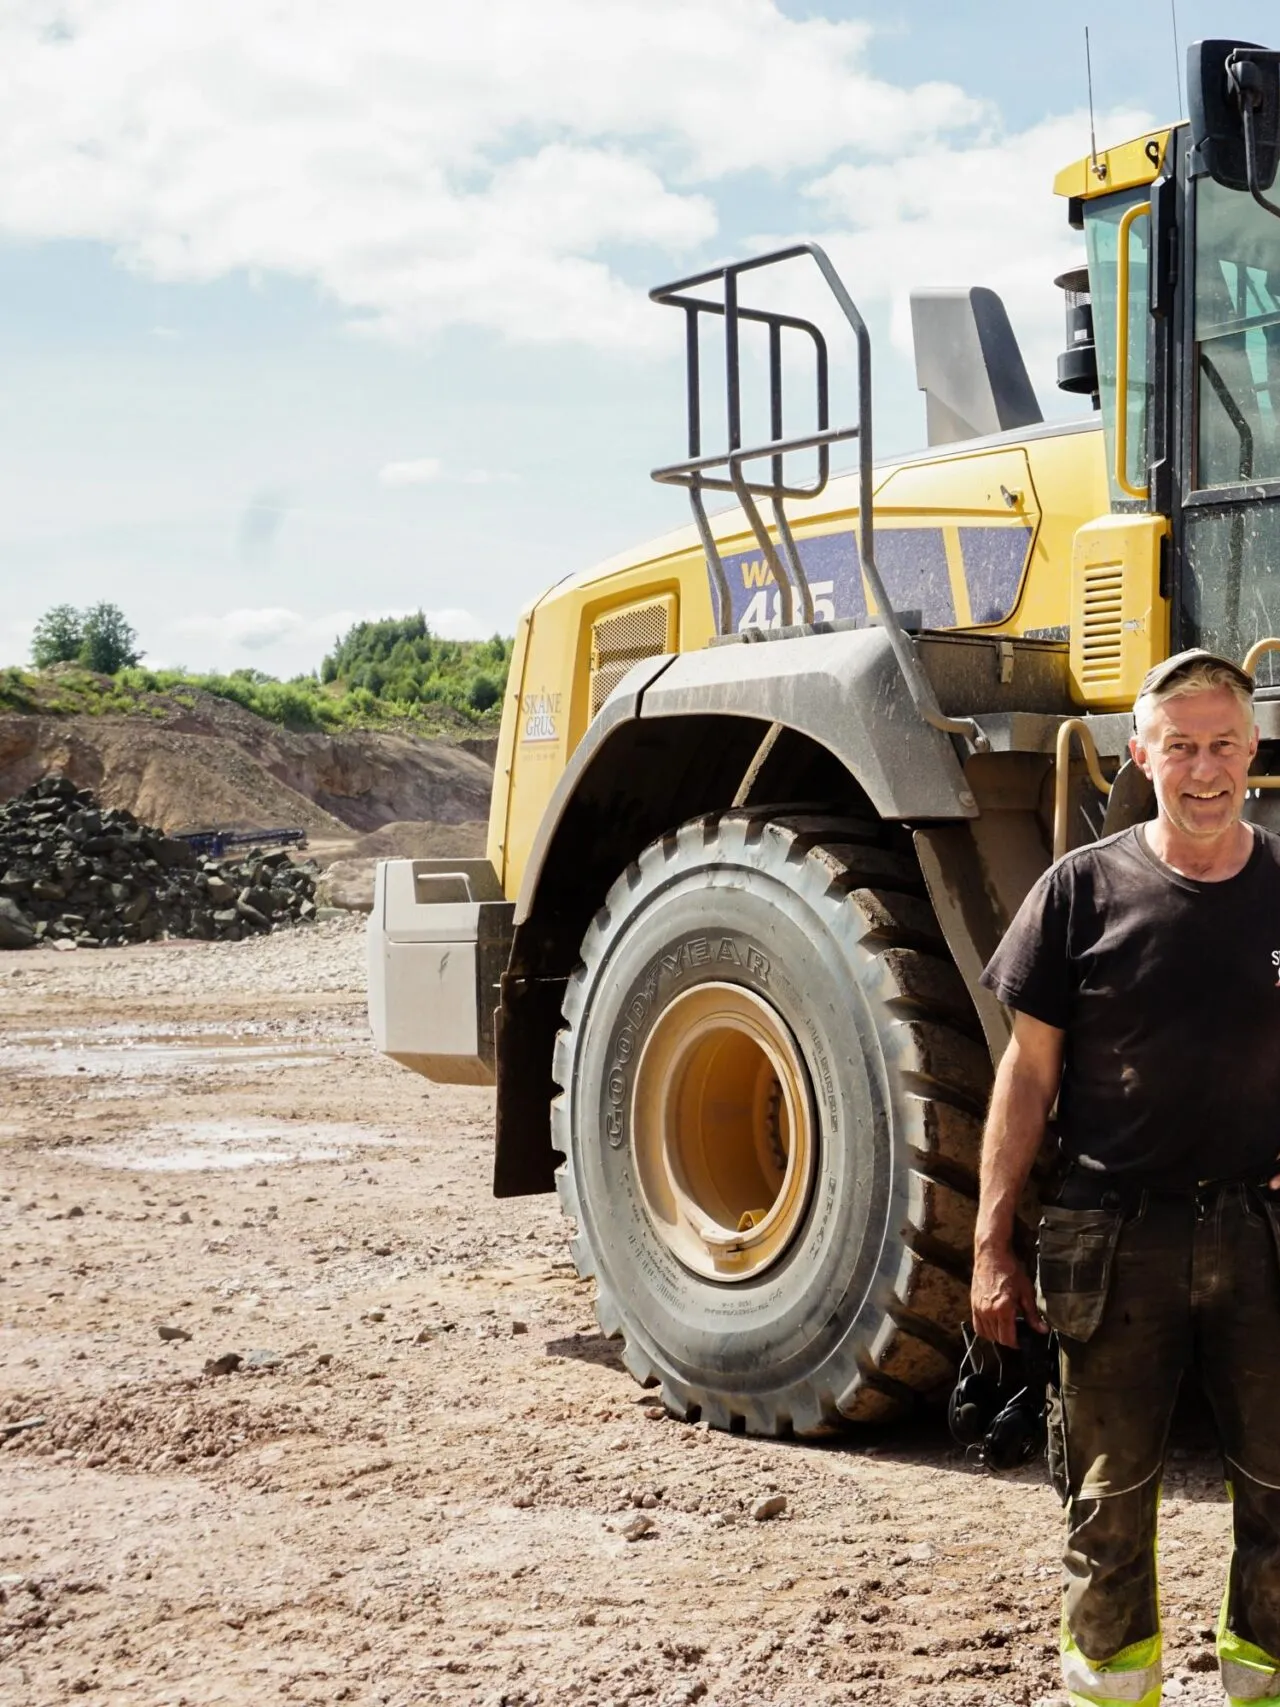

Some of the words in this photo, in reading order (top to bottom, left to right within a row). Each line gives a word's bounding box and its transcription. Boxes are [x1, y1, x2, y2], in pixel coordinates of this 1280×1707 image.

[738, 580, 835, 633] 485
[522, 686, 562, 714] SKÅNE
[526, 715, 556, 737] GRUS
[606, 937, 771, 1147] GOODYEAR
